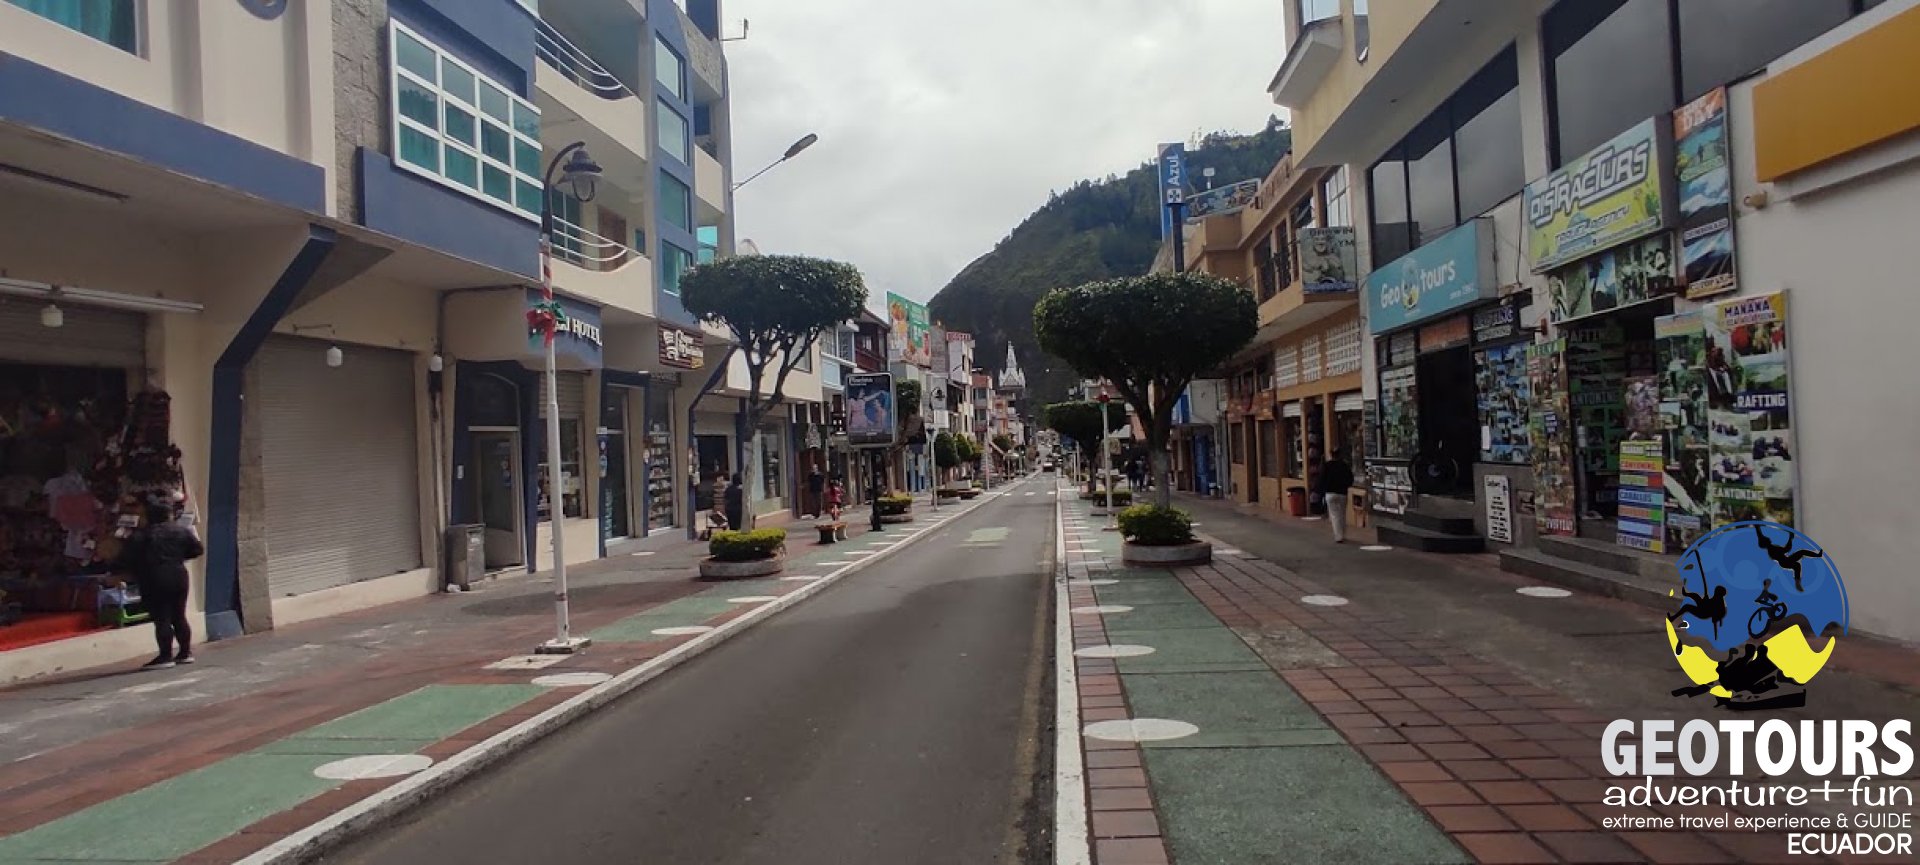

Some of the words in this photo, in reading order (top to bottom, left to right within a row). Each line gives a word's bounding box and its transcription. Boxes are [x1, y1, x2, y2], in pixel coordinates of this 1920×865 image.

[1167, 151, 1181, 187] Azul
[1309, 227, 1353, 236] DARWIN
[1380, 282, 1400, 309] Geo
[1420, 260, 1456, 292] tours
[572, 317, 603, 347] HOTEL
[1737, 394, 1787, 409] RAFTING
